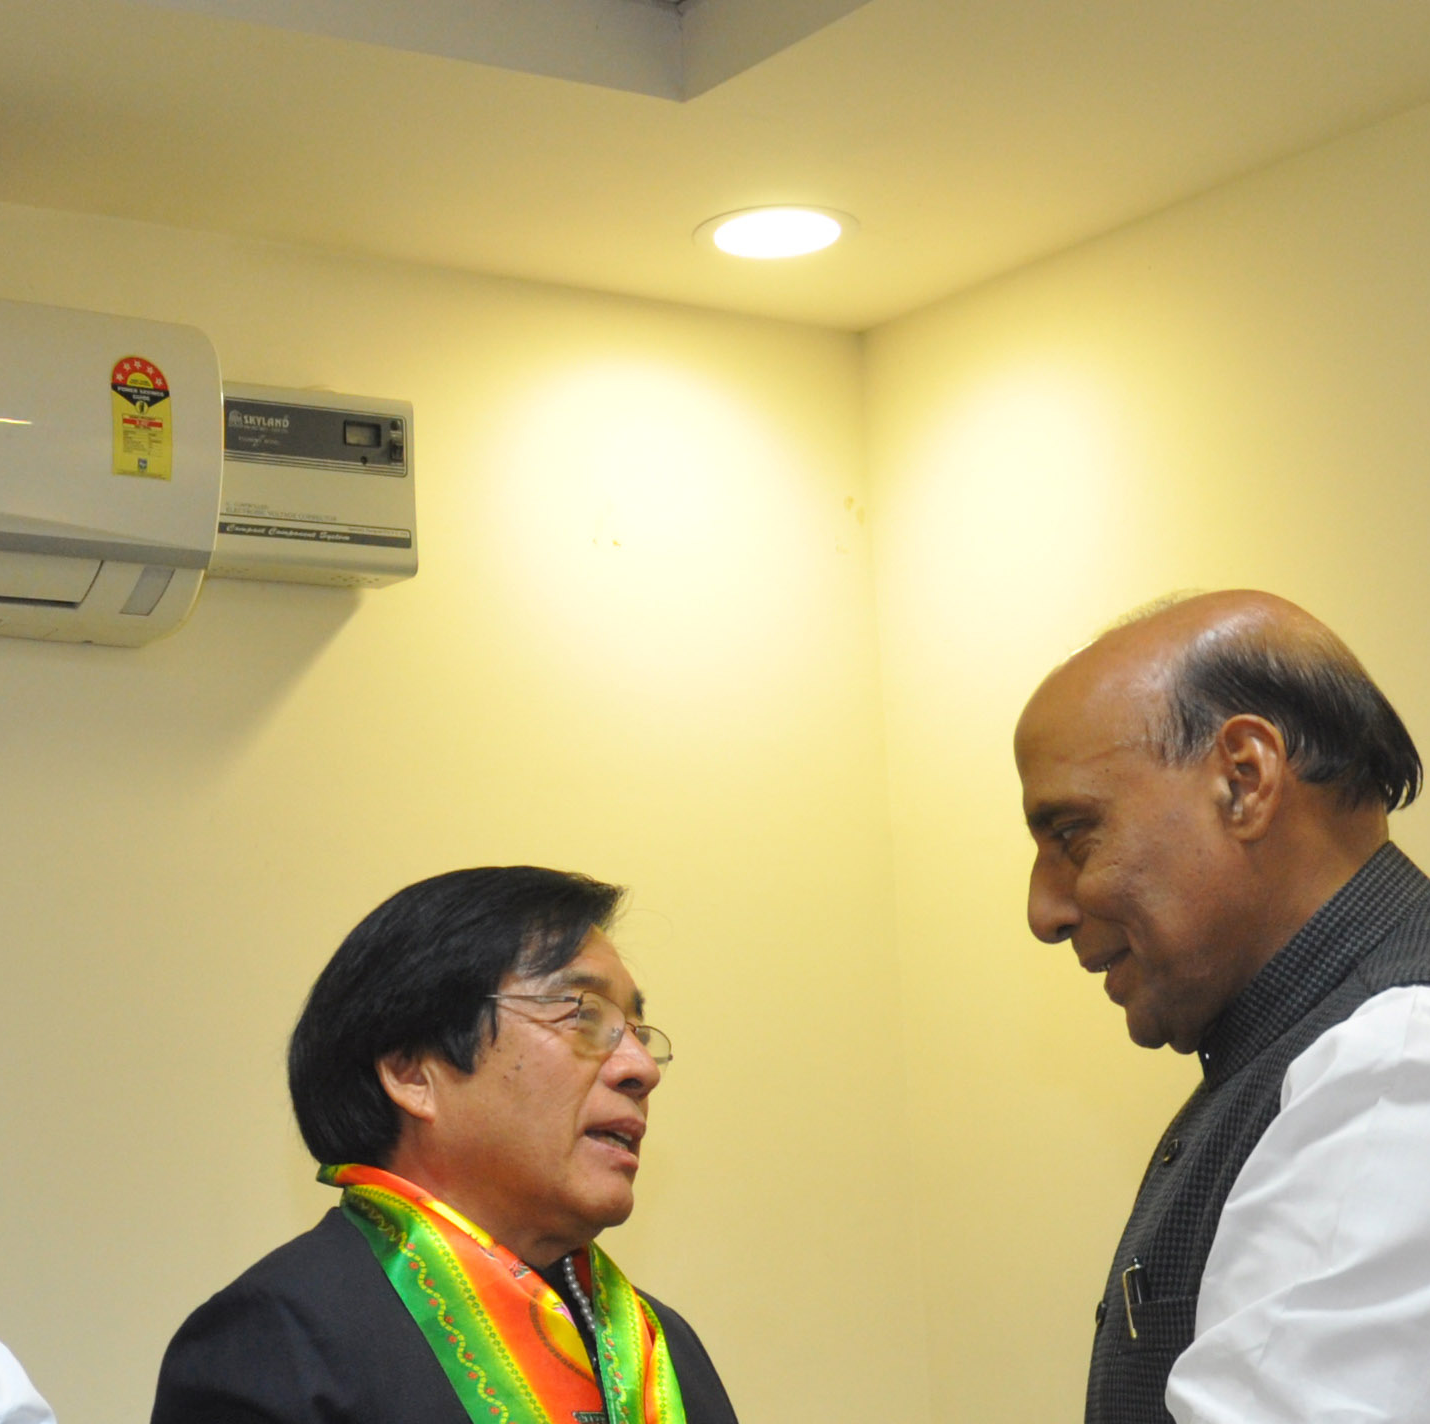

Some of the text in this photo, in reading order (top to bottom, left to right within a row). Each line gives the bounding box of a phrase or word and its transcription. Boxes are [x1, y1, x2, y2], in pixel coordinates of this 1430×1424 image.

[243, 414, 289, 428] SKYLAND
[226, 524, 265, 535] Compact
[268, 527, 316, 539] Component
[319, 531, 351, 541] System
